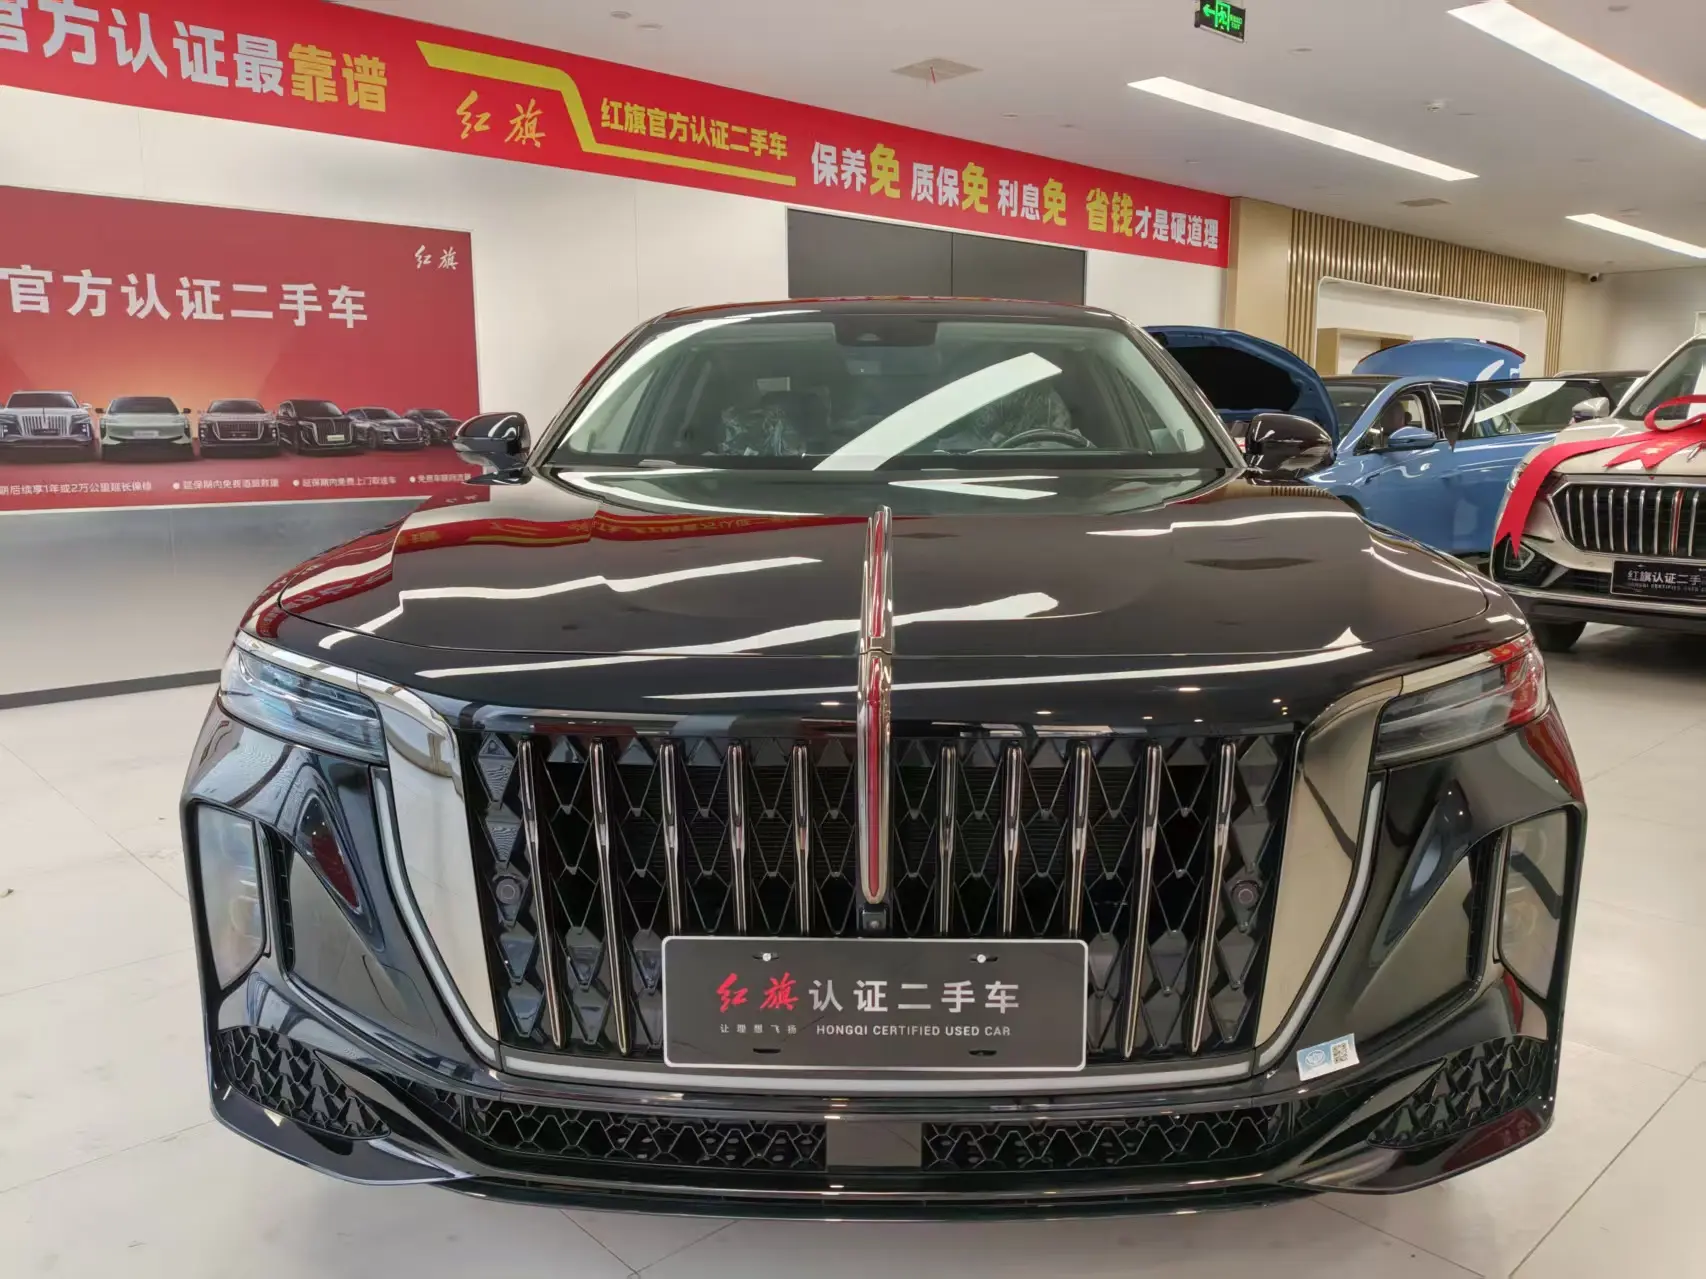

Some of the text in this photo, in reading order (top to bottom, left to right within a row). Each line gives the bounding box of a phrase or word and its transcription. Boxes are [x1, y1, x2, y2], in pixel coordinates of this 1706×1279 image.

[456, 91, 546, 147] 红旗
[600, 97, 788, 161] 红旗官方认证二手车
[810, 142, 1219, 251] 保养免 质保免 利息免 省钱才是硬道理
[414, 244, 458, 270] 红旗
[0, 264, 368, 329] 官方认证二手车
[719, 1023, 797, 1035] 让理想飞扬
[816, 1024, 1011, 1037] HONGQI CERTIFIED USED CAR
